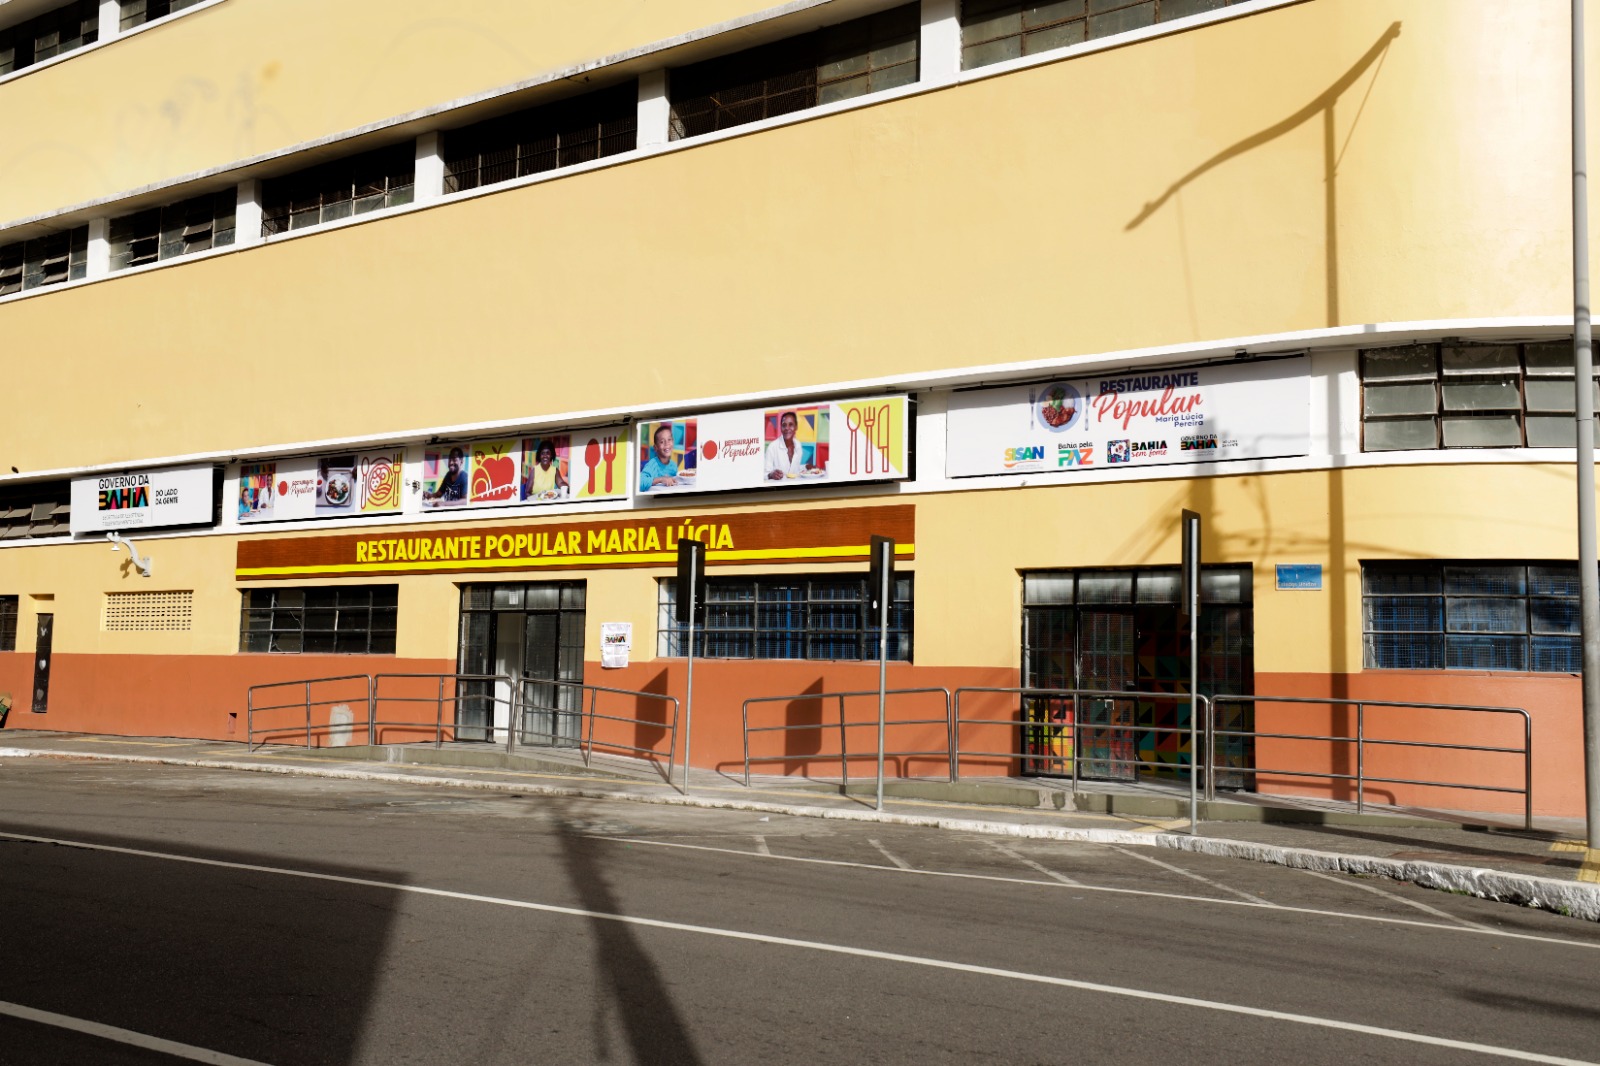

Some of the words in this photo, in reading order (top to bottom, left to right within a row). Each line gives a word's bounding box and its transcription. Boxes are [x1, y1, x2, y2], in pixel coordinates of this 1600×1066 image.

[1101, 372, 1198, 393] RESTAURANTE
[1092, 383, 1203, 431] Popular
[1156, 415, 1179, 423] Maria
[1181, 413, 1204, 421] Lúcia
[724, 437, 759, 446] RESTAURANTE
[1058, 442, 1077, 450] Bahia
[1079, 441, 1093, 449] pela
[1131, 440, 1168, 451] BAHIA
[1180, 440, 1218, 450] BAHIA
[722, 445, 760, 462] Popular
[1004, 446, 1044, 461] SISAN
[1058, 448, 1093, 467] PAZ
[1149, 449, 1168, 457] fome
[99, 475, 137, 489] GOVERNO
[138, 475, 150, 486] DA
[164, 488, 178, 496] LADO
[98, 486, 150, 511] BAHIA
[163, 496, 178, 505] GENTE
[356, 535, 481, 563] RESTAURANTE
[485, 531, 582, 559] POPULAR
[587, 526, 662, 554] MARIA
[666, 518, 734, 551] LÚCIA
